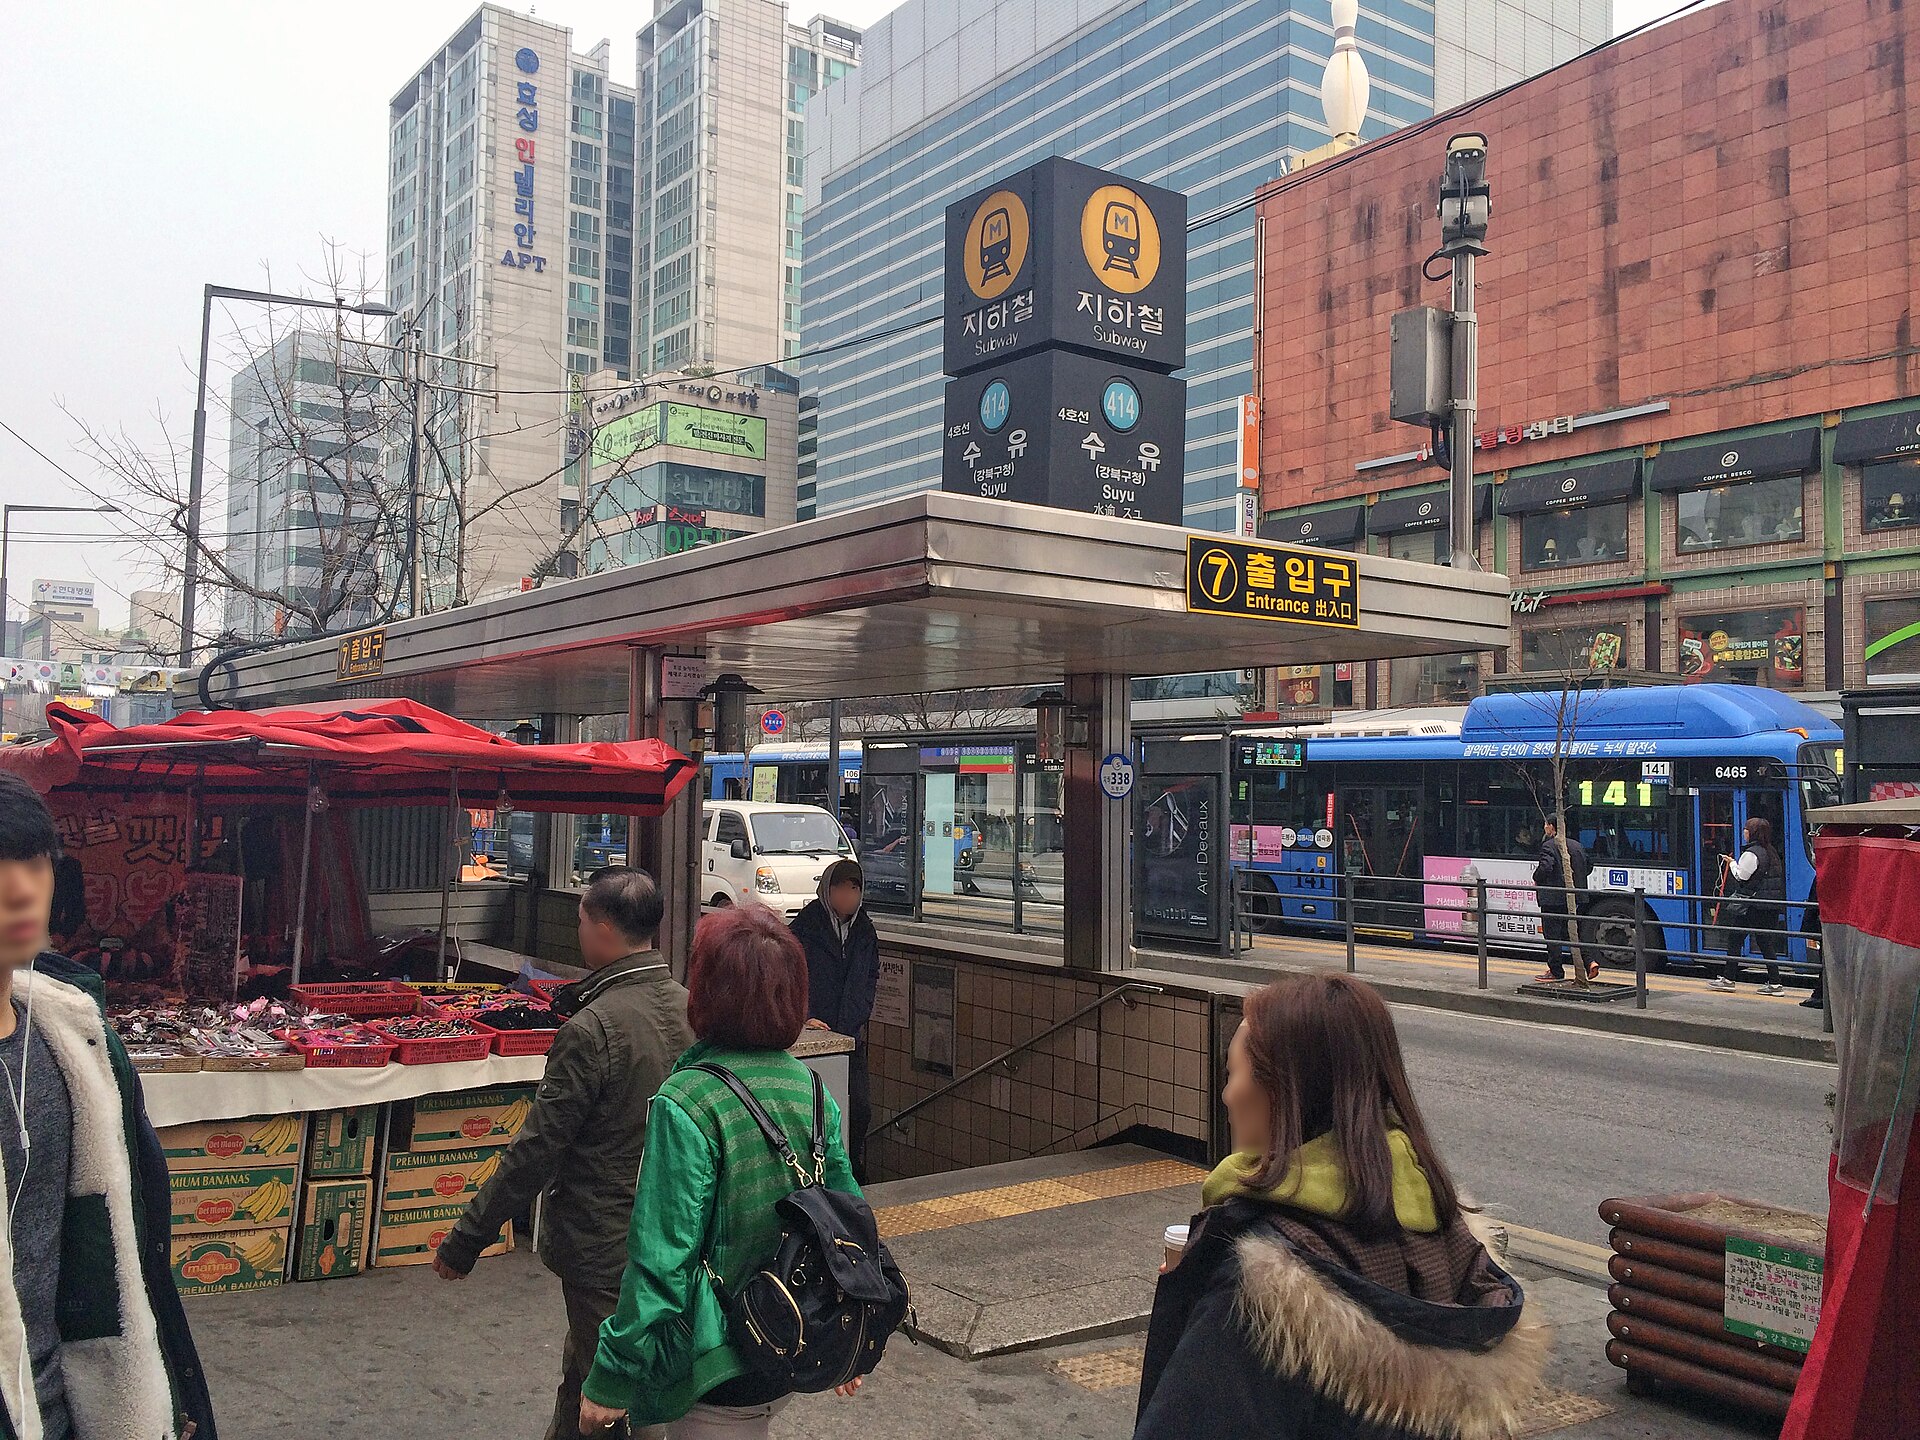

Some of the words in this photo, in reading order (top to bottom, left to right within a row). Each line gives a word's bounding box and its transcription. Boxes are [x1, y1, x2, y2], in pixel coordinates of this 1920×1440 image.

[517, 81, 538, 132] 효성
[501, 250, 546, 273] APT
[962, 290, 1034, 337] 지하철
[1076, 290, 1163, 336] 지하철
[974, 331, 1019, 356] Subway
[1093, 325, 1148, 354] Subway
[983, 389, 1006, 420] 414
[1107, 390, 1135, 420] 414
[1058, 407, 1090, 424] 4호선
[947, 421, 970, 439] 4호선
[962, 429, 1028, 468] 수유
[1080, 431, 1161, 472] 수유
[1895, 443, 1920, 452] COFFE
[973, 461, 1016, 484] (강북구청)
[1095, 463, 1146, 486] (강북구청)
[1703, 473, 1728, 482] COFFEE
[980, 480, 1007, 498] Suyu
[1102, 485, 1135, 503] Suyu
[1546, 497, 1567, 506] COFFEE
[1404, 520, 1423, 528] COFFEE
[1208, 556, 1229, 596] 7
[1245, 552, 1351, 598] 출입구
[1246, 591, 1310, 614] Entrance
[1315, 598, 1352, 620] 出入口
[351, 634, 382, 660] 출입구
[1300, 680, 1312, 690] 1+1
[1500, 743, 1530, 757] 당신이
[1603, 741, 1626, 755] 녹색
[1626, 741, 1657, 755] 발전소
[1644, 763, 1668, 775] 141
[1715, 766, 1747, 778] 6465
[1111, 772, 1130, 785] 338
[1578, 780, 1652, 806] 141
[1197, 800, 1208, 864] Decaux
[1197, 872, 1208, 895] Art
[1295, 867, 1325, 889] 141
[1612, 873, 1625, 883] 141
[1431, 920, 1459, 930] 지성피부
[1497, 921, 1536, 936] 멘토크림
[422, 1096, 465, 1109] PREMIUM
[465, 1094, 505, 1106] BANANAS
[208, 1140, 219, 1149] Del
[220, 1138, 243, 1149] Monte
[396, 1155, 437, 1167] PREMIUM
[439, 1150, 479, 1163] BANANAS
[171, 1176, 200, 1188] MIUM
[202, 1173, 250, 1187] BANANAS
[198, 1207, 209, 1216] Del
[209, 1205, 233, 1215] Monte
[388, 1211, 430, 1223] PREMIUM
[433, 1207, 464, 1219] BANAN
[187, 1261, 233, 1274] manna
[177, 1283, 227, 1295] PREMIUM
[230, 1278, 280, 1291] BANANAS
